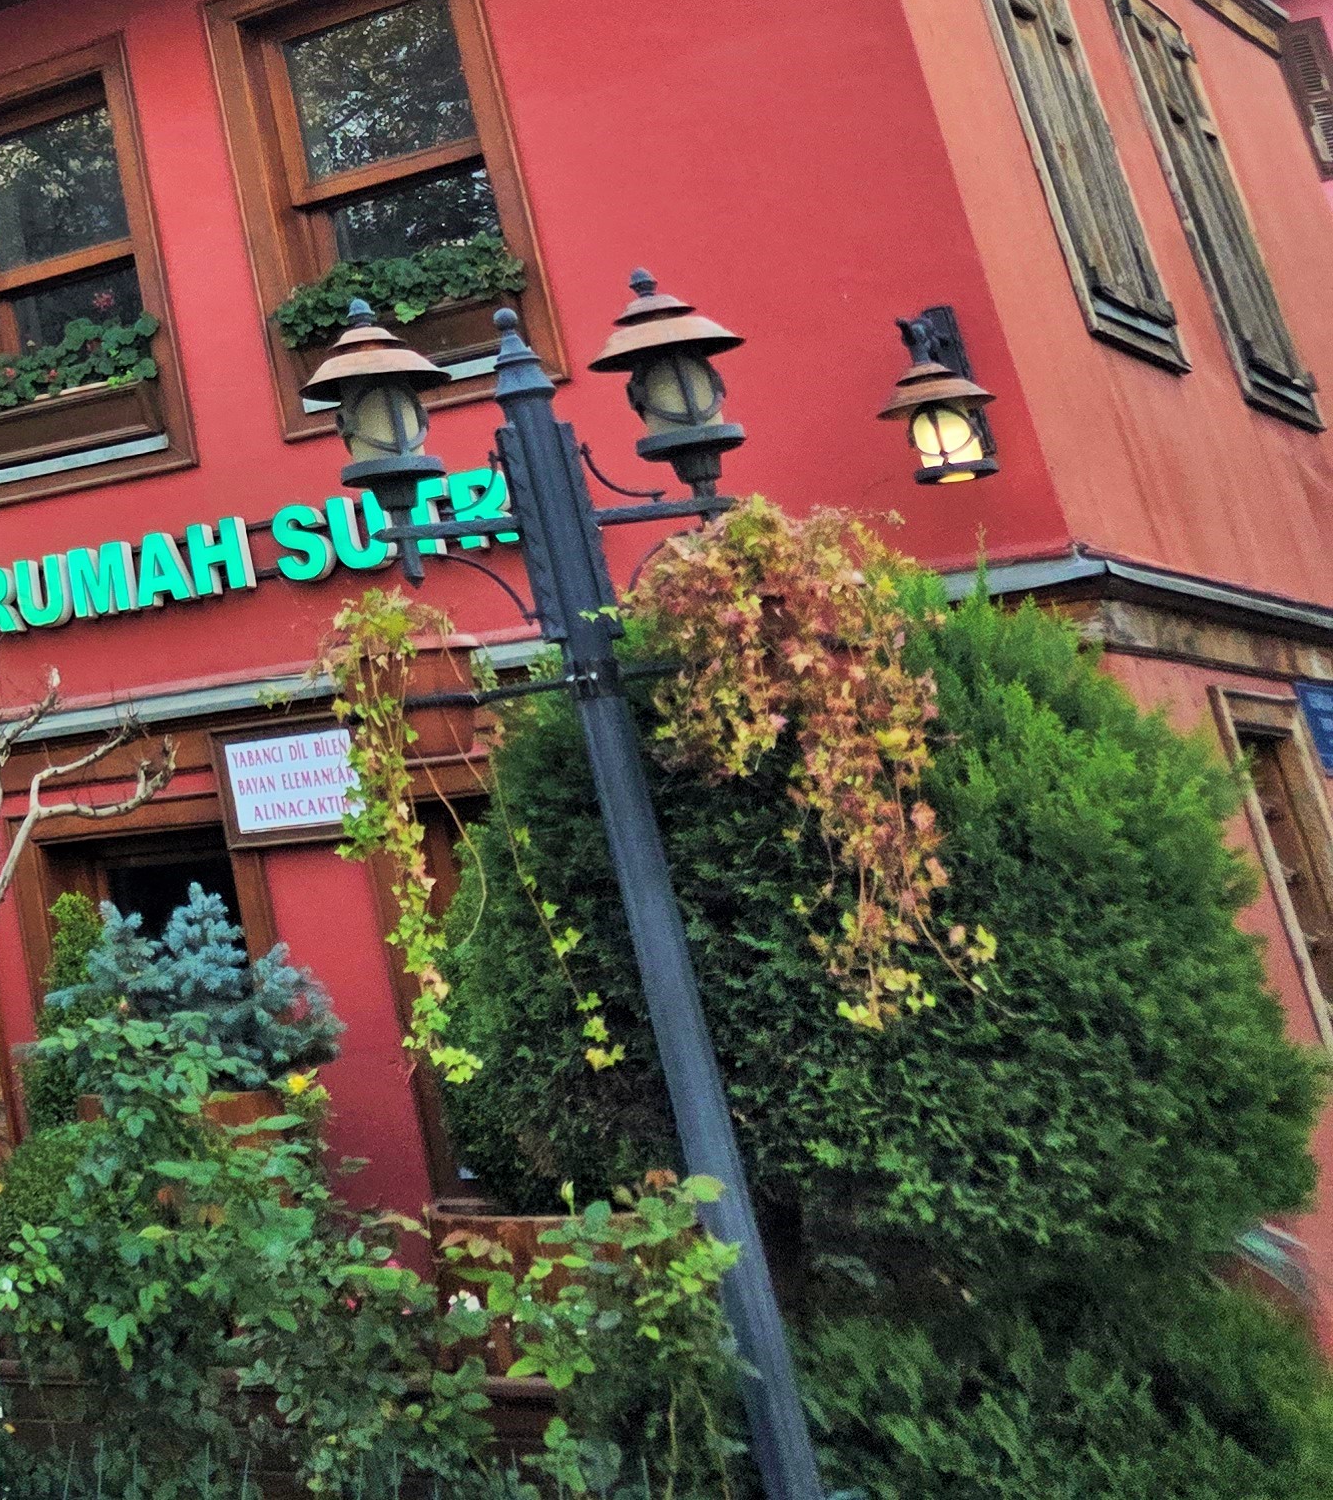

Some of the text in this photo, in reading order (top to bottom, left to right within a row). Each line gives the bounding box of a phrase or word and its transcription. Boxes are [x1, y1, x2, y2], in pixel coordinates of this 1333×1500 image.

[232, 736, 349, 768] YABANCI DİL BİLEN
[238, 767, 355, 796] BAYAN ELEMANLAR
[253, 795, 350, 822] ALINACAKTIR
